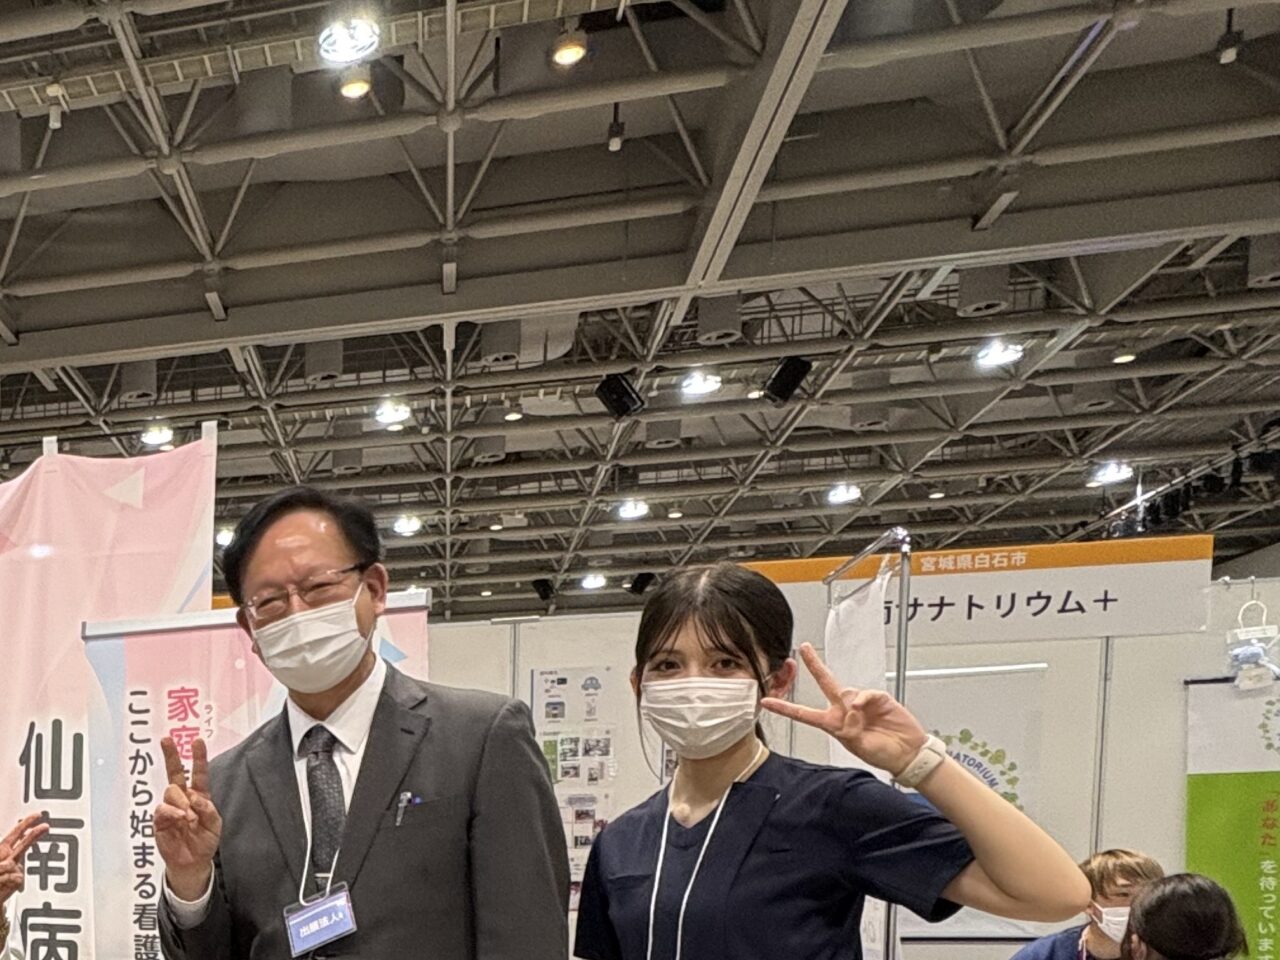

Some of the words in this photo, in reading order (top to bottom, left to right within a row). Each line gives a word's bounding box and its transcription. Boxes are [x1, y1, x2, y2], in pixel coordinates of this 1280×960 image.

[921, 552, 1027, 572] 宮城県白石市
[204, 704, 214, 738] ライフ
